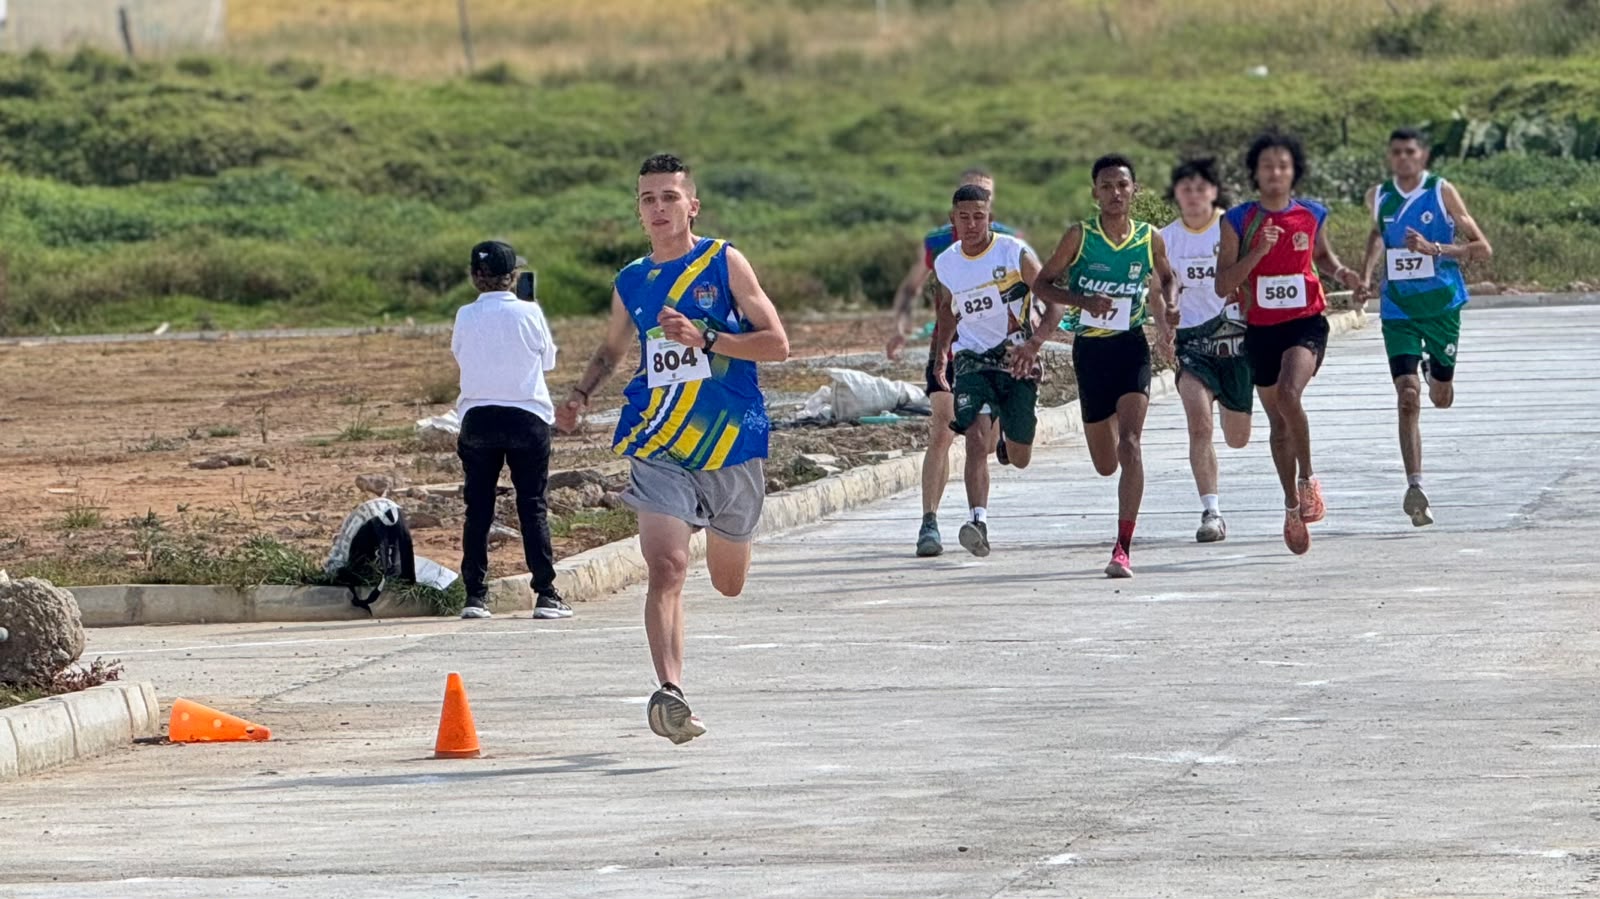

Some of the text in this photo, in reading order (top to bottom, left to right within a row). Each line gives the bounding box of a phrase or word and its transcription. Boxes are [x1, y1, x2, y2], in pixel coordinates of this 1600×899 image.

[1395, 257, 1423, 271] 537
[1187, 266, 1216, 279] 834
[1265, 286, 1298, 300] 580
[964, 296, 993, 314] 829
[653, 347, 698, 373] 804
